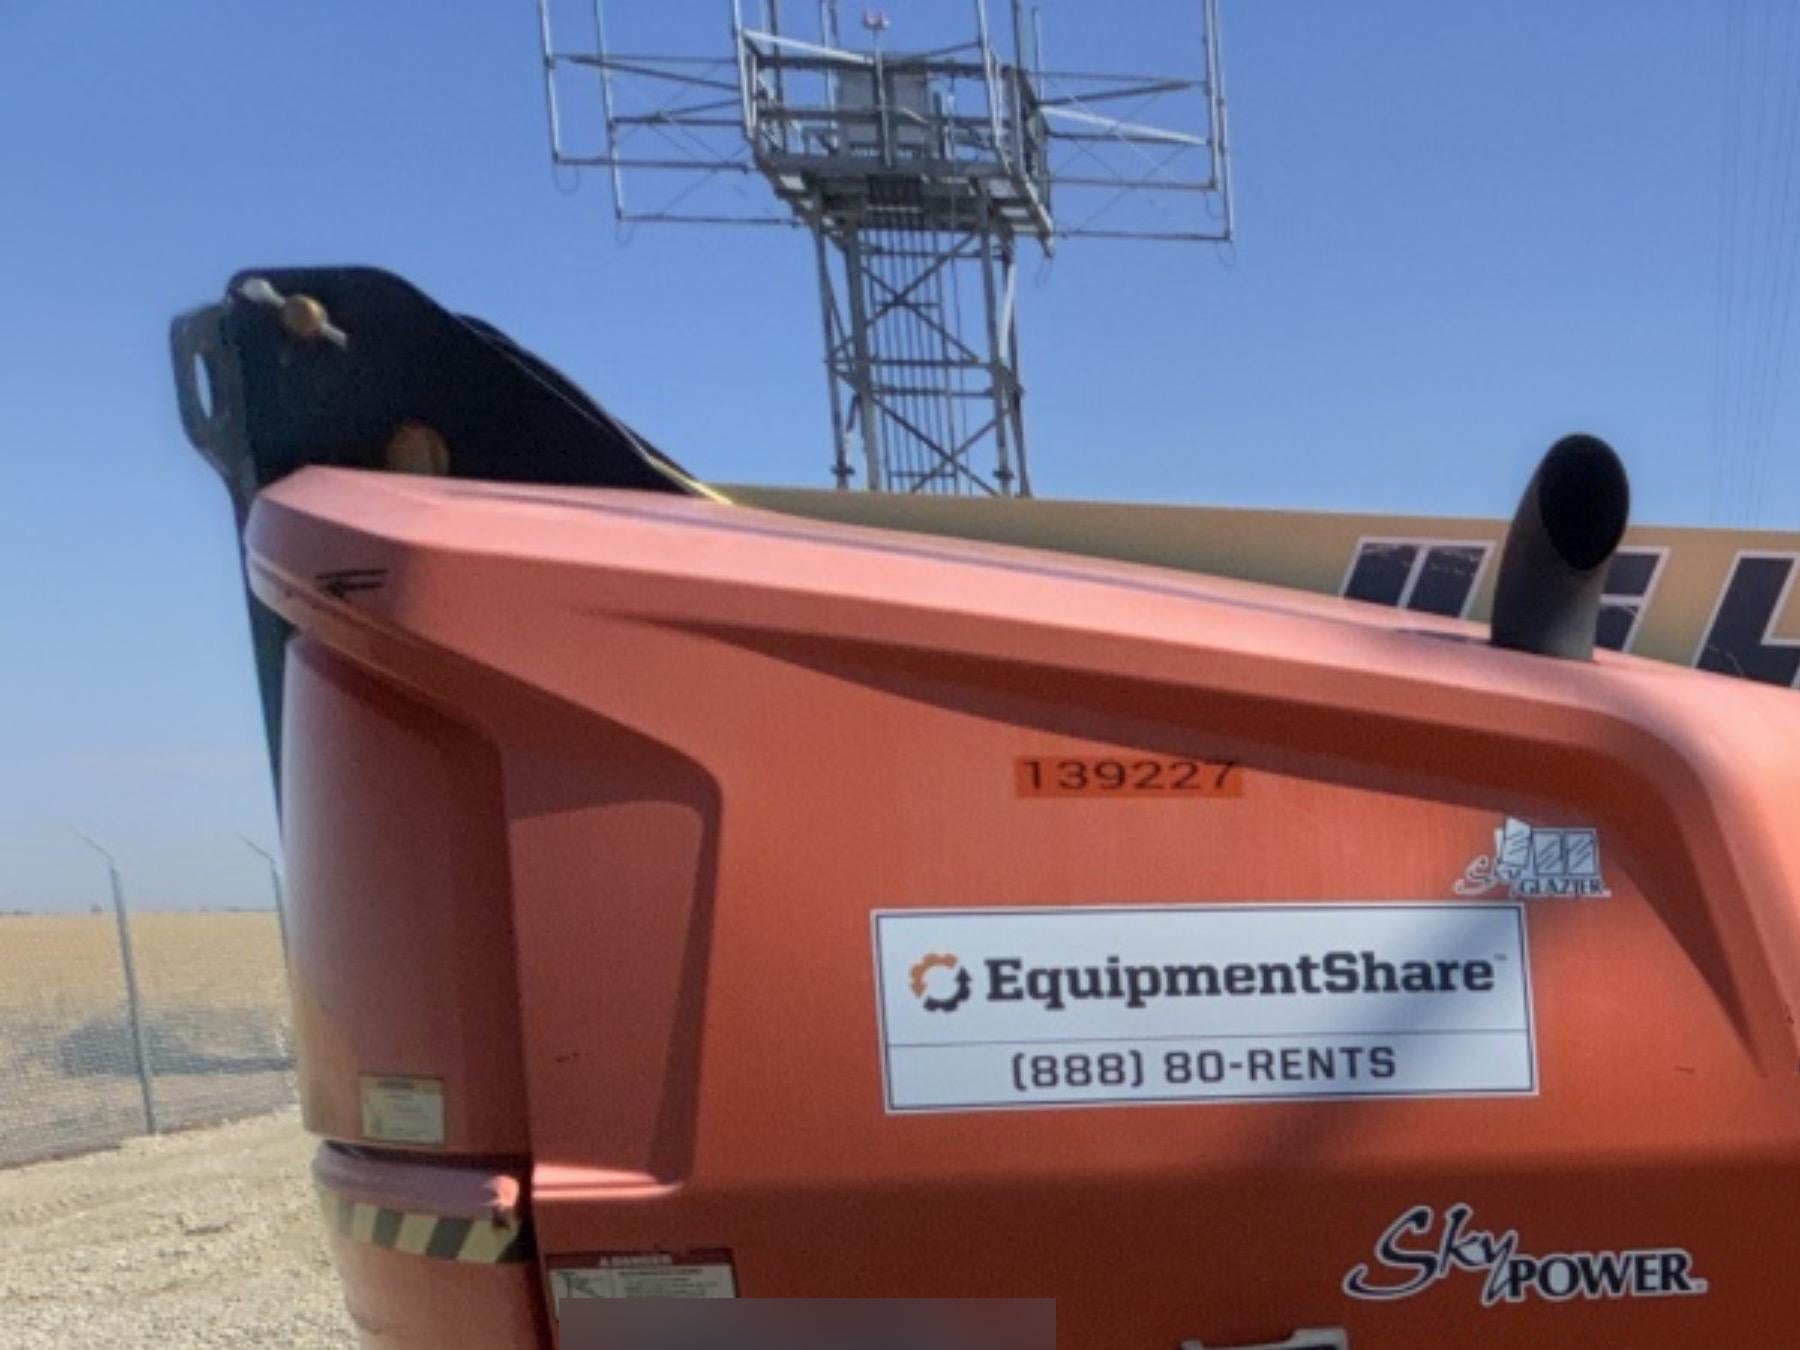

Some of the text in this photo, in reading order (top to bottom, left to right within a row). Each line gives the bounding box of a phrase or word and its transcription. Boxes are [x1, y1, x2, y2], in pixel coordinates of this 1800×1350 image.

[1023, 761, 1235, 790] 139227
[985, 950, 1495, 1009] EquipmentShare
[1012, 1046, 1397, 1091] (888) 80-RENTS
